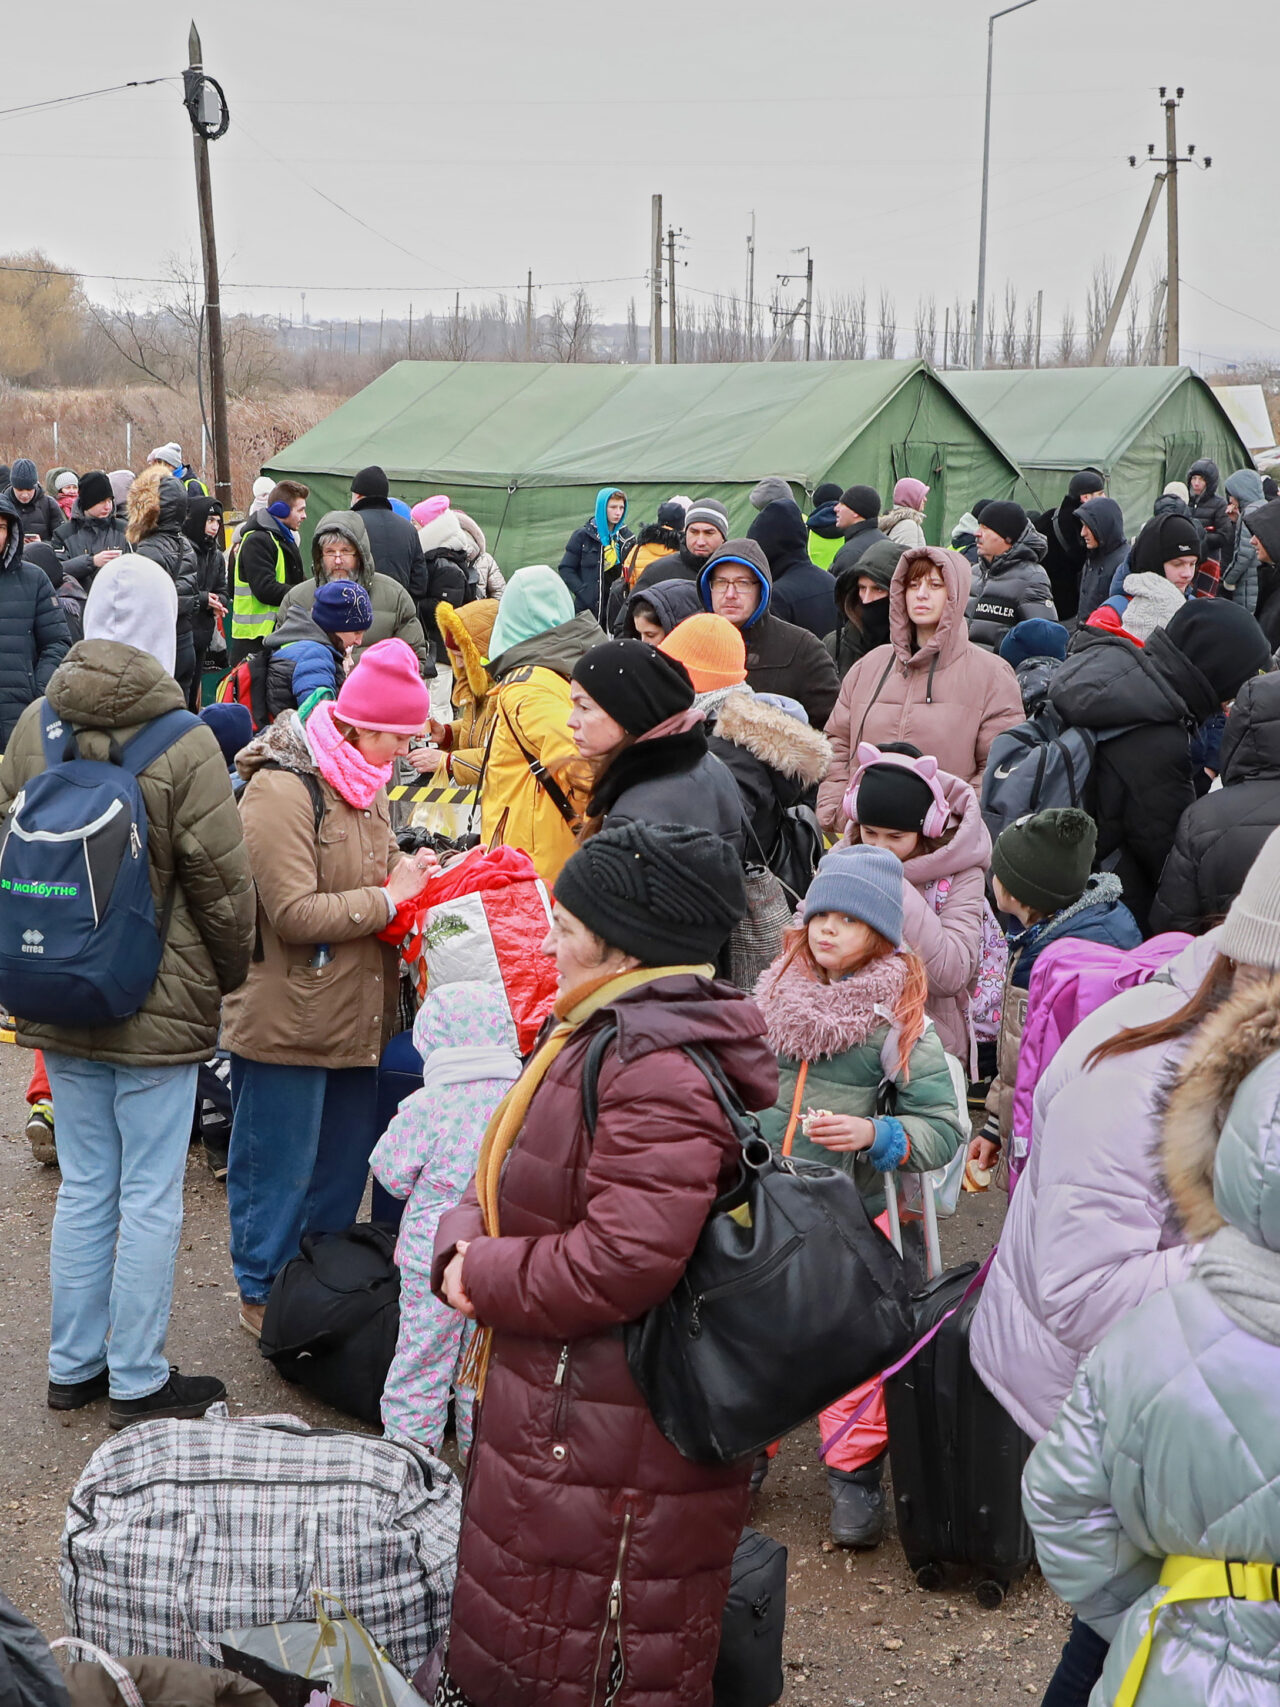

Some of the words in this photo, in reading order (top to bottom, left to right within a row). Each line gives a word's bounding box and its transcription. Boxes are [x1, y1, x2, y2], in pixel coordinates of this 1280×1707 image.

[976, 603, 1014, 617] MONCLER
[1, 879, 11, 889] за
[14, 881, 78, 898] майбутнє
